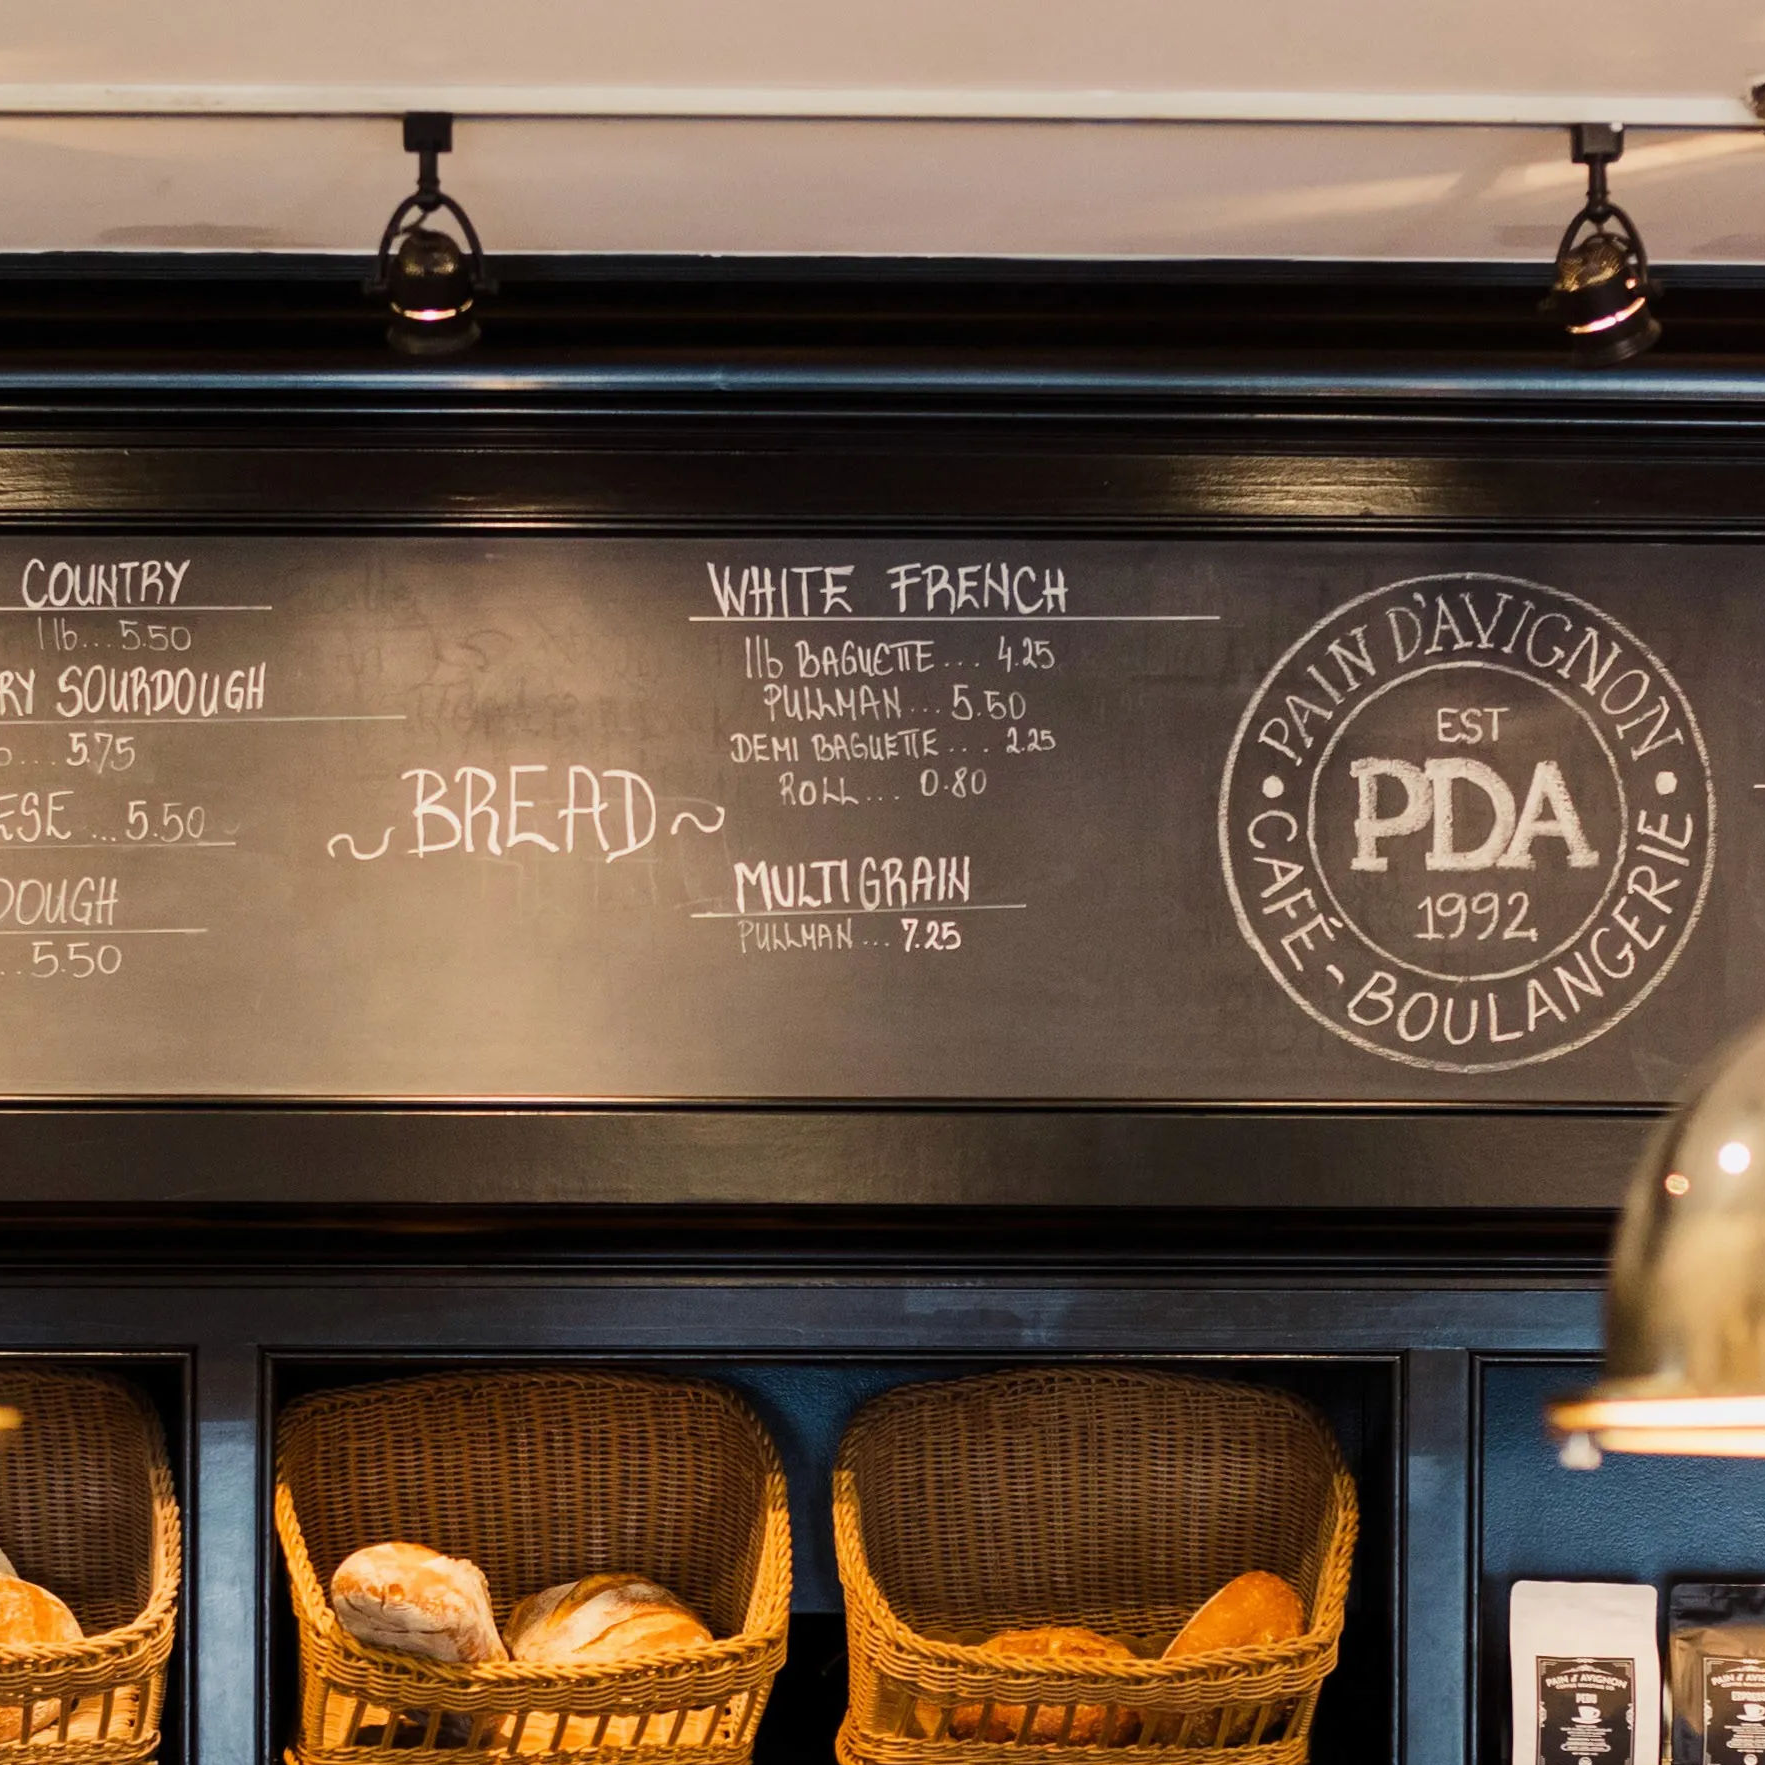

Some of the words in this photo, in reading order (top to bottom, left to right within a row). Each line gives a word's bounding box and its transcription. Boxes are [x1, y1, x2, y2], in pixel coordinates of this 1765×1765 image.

[22, 560, 190, 607] COUNTRY
[706, 561, 855, 618] WHITE
[889, 563, 1069, 615] FRENCH
[119, 619, 191, 653] 5.50
[998, 637, 1057, 671] 4.25
[55, 662, 267, 718] SOURDOUGH
[1258, 623, 1374, 769] PAIN
[1386, 591, 1689, 759] D'AVIGNON
[951, 687, 1027, 722] 5.50
[1436, 706, 1509, 744] EST
[66, 731, 136, 774] 5.75
[731, 733, 799, 764] DEMI
[1005, 726, 1057, 756] 2.25
[920, 768, 988, 798] 0.80
[125, 800, 205, 843] 5.50
[401, 764, 657, 865] BREAD
[1347, 756, 1598, 873] PDA
[734, 856, 971, 914] MULTIGRAIN
[901, 919, 962, 952] 7.25
[1246, 809, 1340, 976] CAFÉ
[1346, 809, 1694, 1046] BOULANGERIE
[1414, 891, 1539, 941] 1992
[32, 941, 121, 979] 5.50
